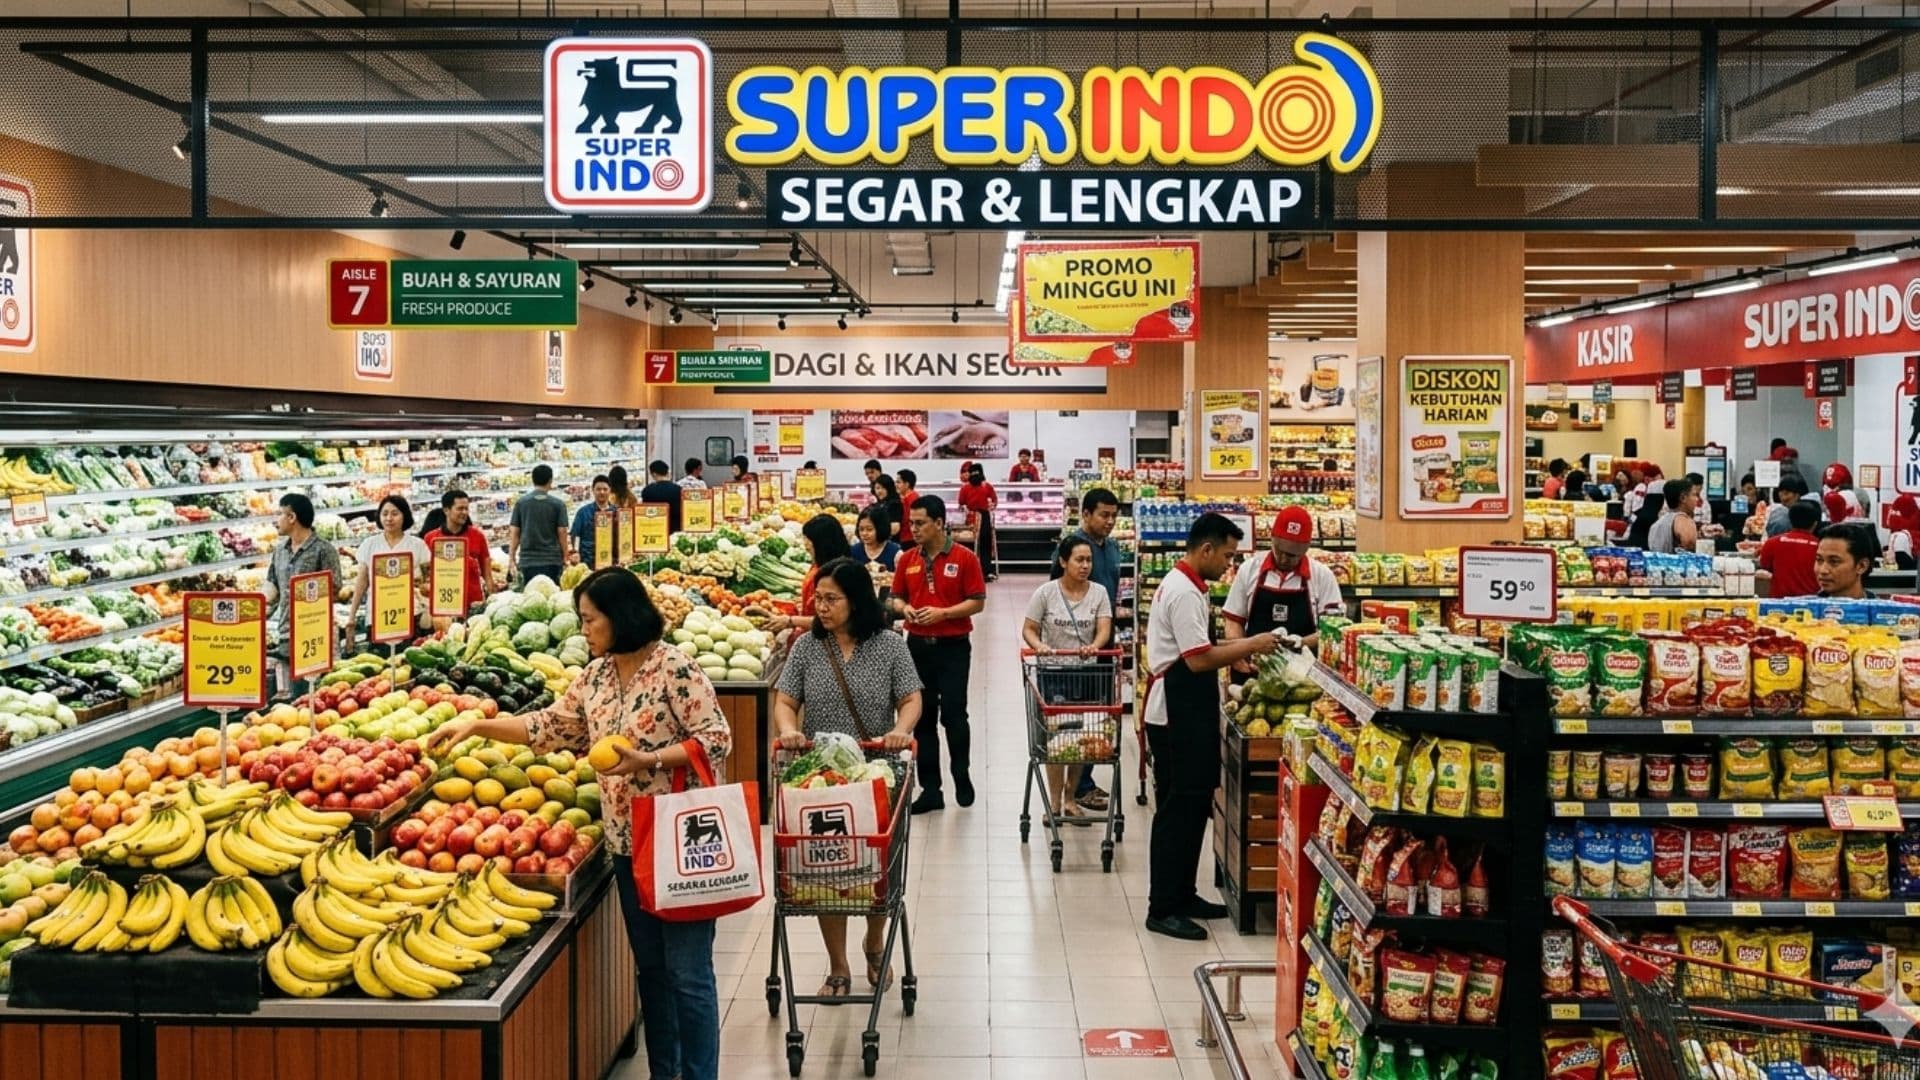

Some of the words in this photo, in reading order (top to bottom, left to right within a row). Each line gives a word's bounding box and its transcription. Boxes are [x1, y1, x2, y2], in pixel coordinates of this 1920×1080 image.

[735, 75, 1067, 154] SUPER
[1091, 75, 1336, 155] INDO
[585, 138, 672, 156] SUPER
[575, 159, 684, 191] INDO
[780, 177, 965, 223] SEGAR
[980, 177, 1022, 223] &
[1039, 177, 1302, 223] LENGKAP
[342, 269, 377, 280] AISLE
[1065, 257, 1153, 278] PROMO
[402, 272, 453, 288] BUAH
[457, 272, 471, 288] &
[475, 272, 561, 288] SAYURAN
[1043, 281, 1138, 300] MINGGU
[1145, 279, 1176, 297] INI
[348, 285, 370, 316] 7
[401, 302, 444, 316] FRESH
[447, 302, 512, 316] PRODUCE
[1744, 293, 1839, 349] SUPER
[1578, 324, 1634, 367] KASIR
[653, 363, 666, 379] 7
[774, 353, 846, 376] DAGI
[855, 353, 876, 376] &
[885, 353, 957, 376] IKAN
[1412, 369, 1500, 390] DISKON
[1410, 394, 1502, 406] KEBUTUHAN
[1424, 408, 1488, 421] HARIAN
[1489, 580, 1518, 601] 59
